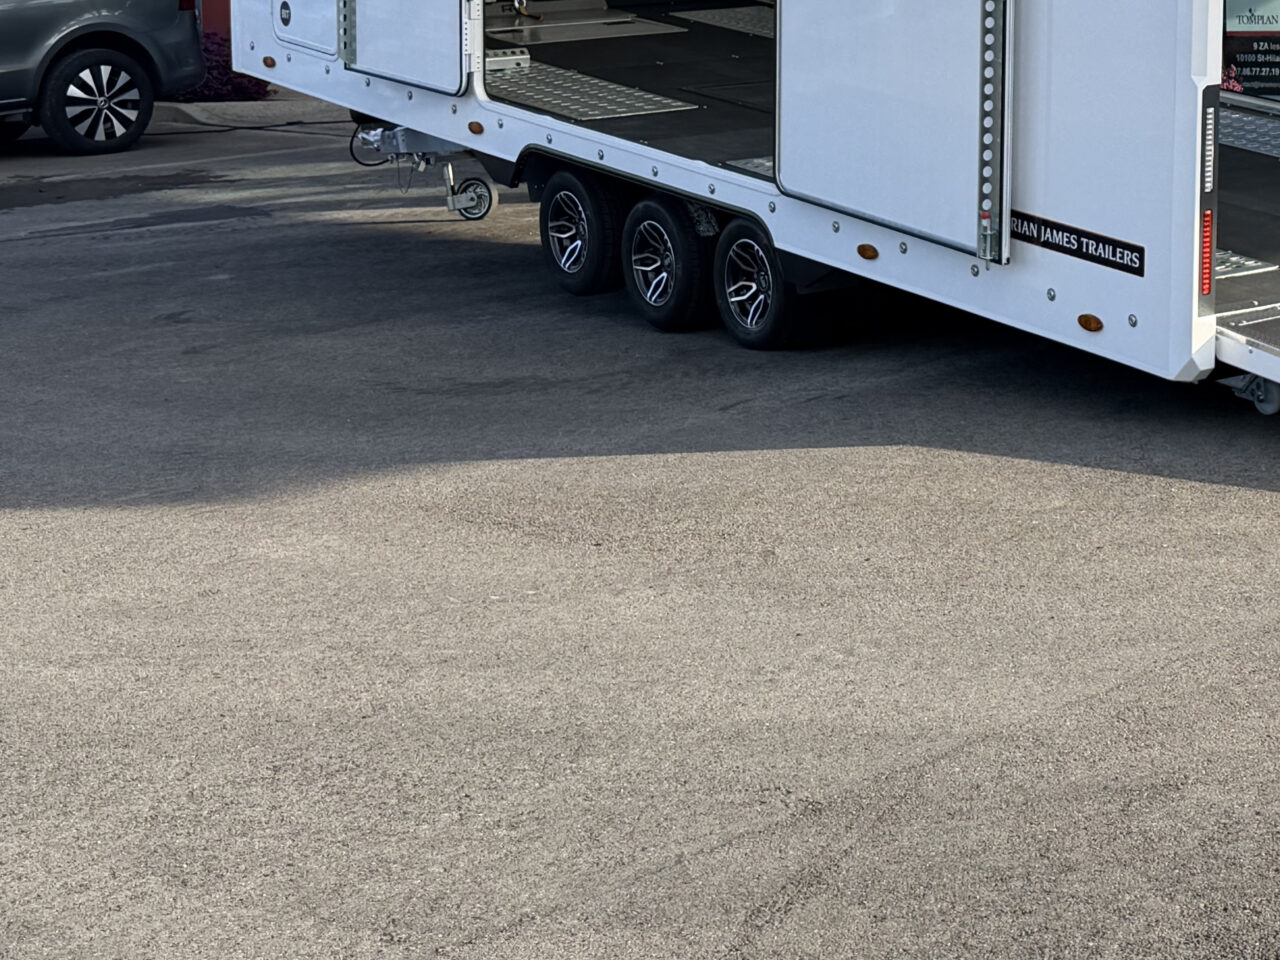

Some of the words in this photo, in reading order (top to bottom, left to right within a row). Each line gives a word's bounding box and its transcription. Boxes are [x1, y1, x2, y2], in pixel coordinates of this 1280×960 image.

[1258, 42, 1269, 50] ZA
[1040, 225, 1078, 250] JAMES
[1080, 237, 1140, 268] TRAILERS
